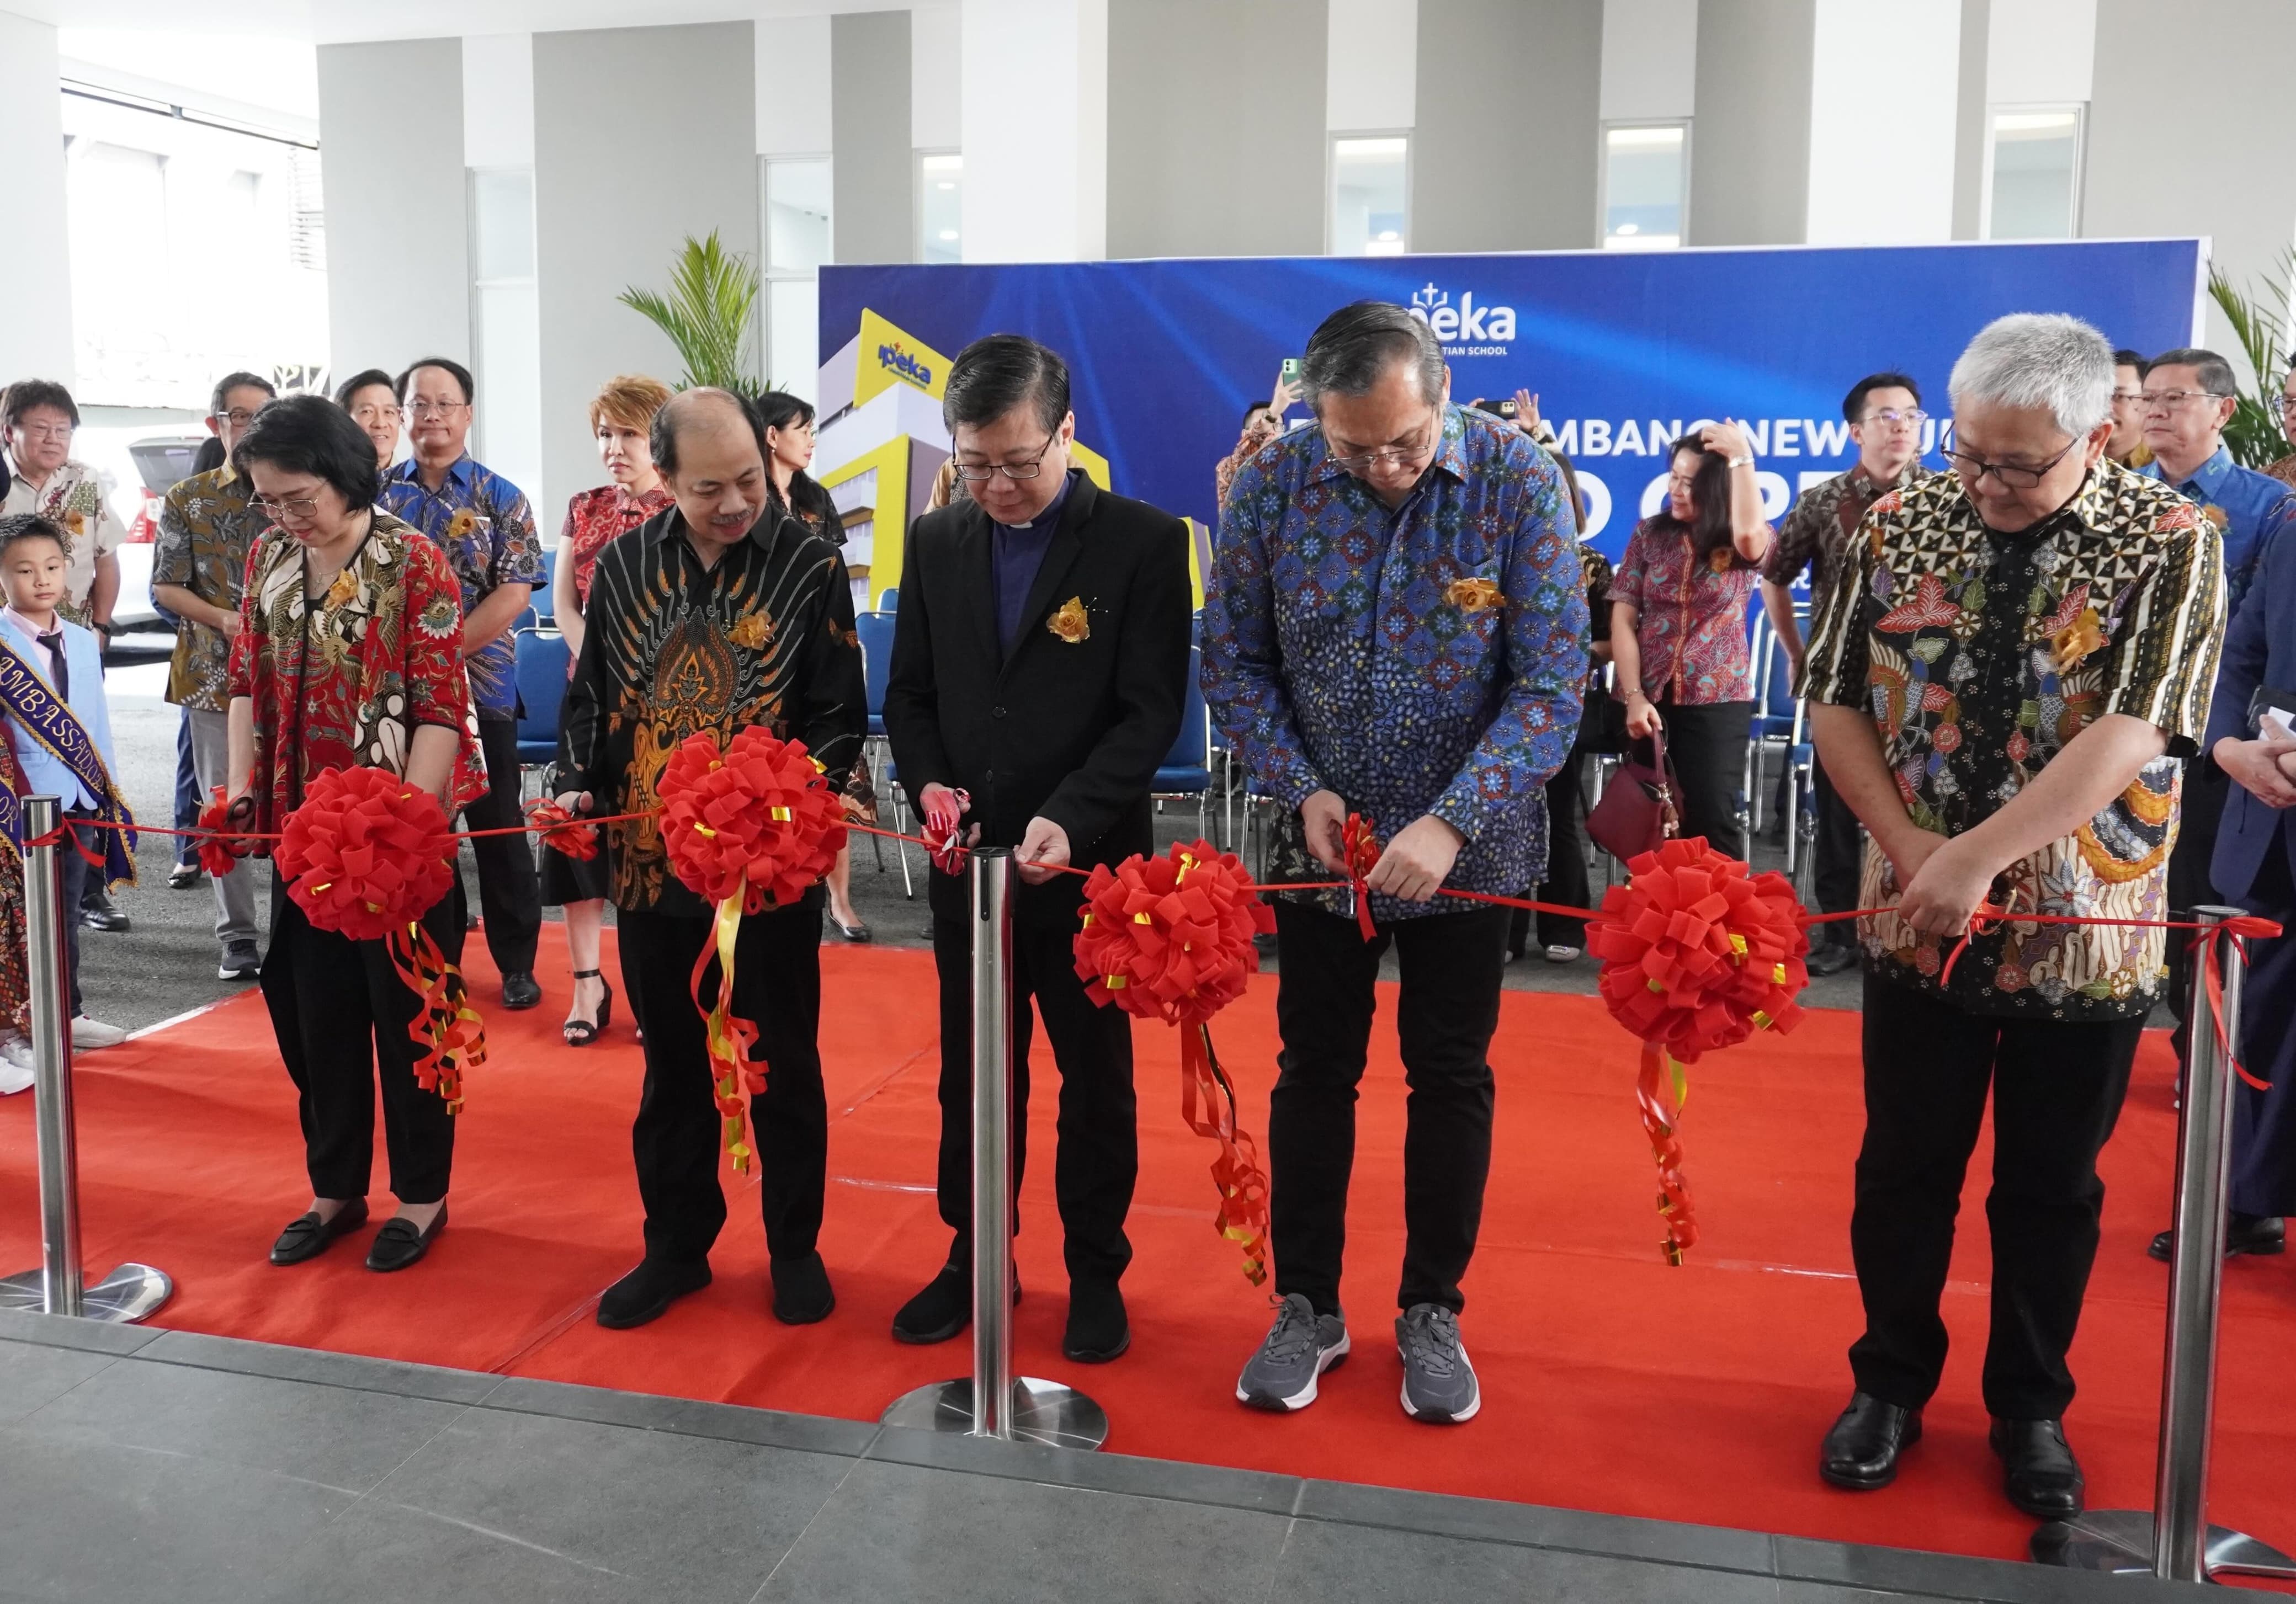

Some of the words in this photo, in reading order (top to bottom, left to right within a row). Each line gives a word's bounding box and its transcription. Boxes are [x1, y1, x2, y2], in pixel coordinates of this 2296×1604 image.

[1468, 346, 1508, 355] SCHOOL
[1738, 419, 1850, 456] NEW
[0, 657, 104, 787] AMBASSADOR
